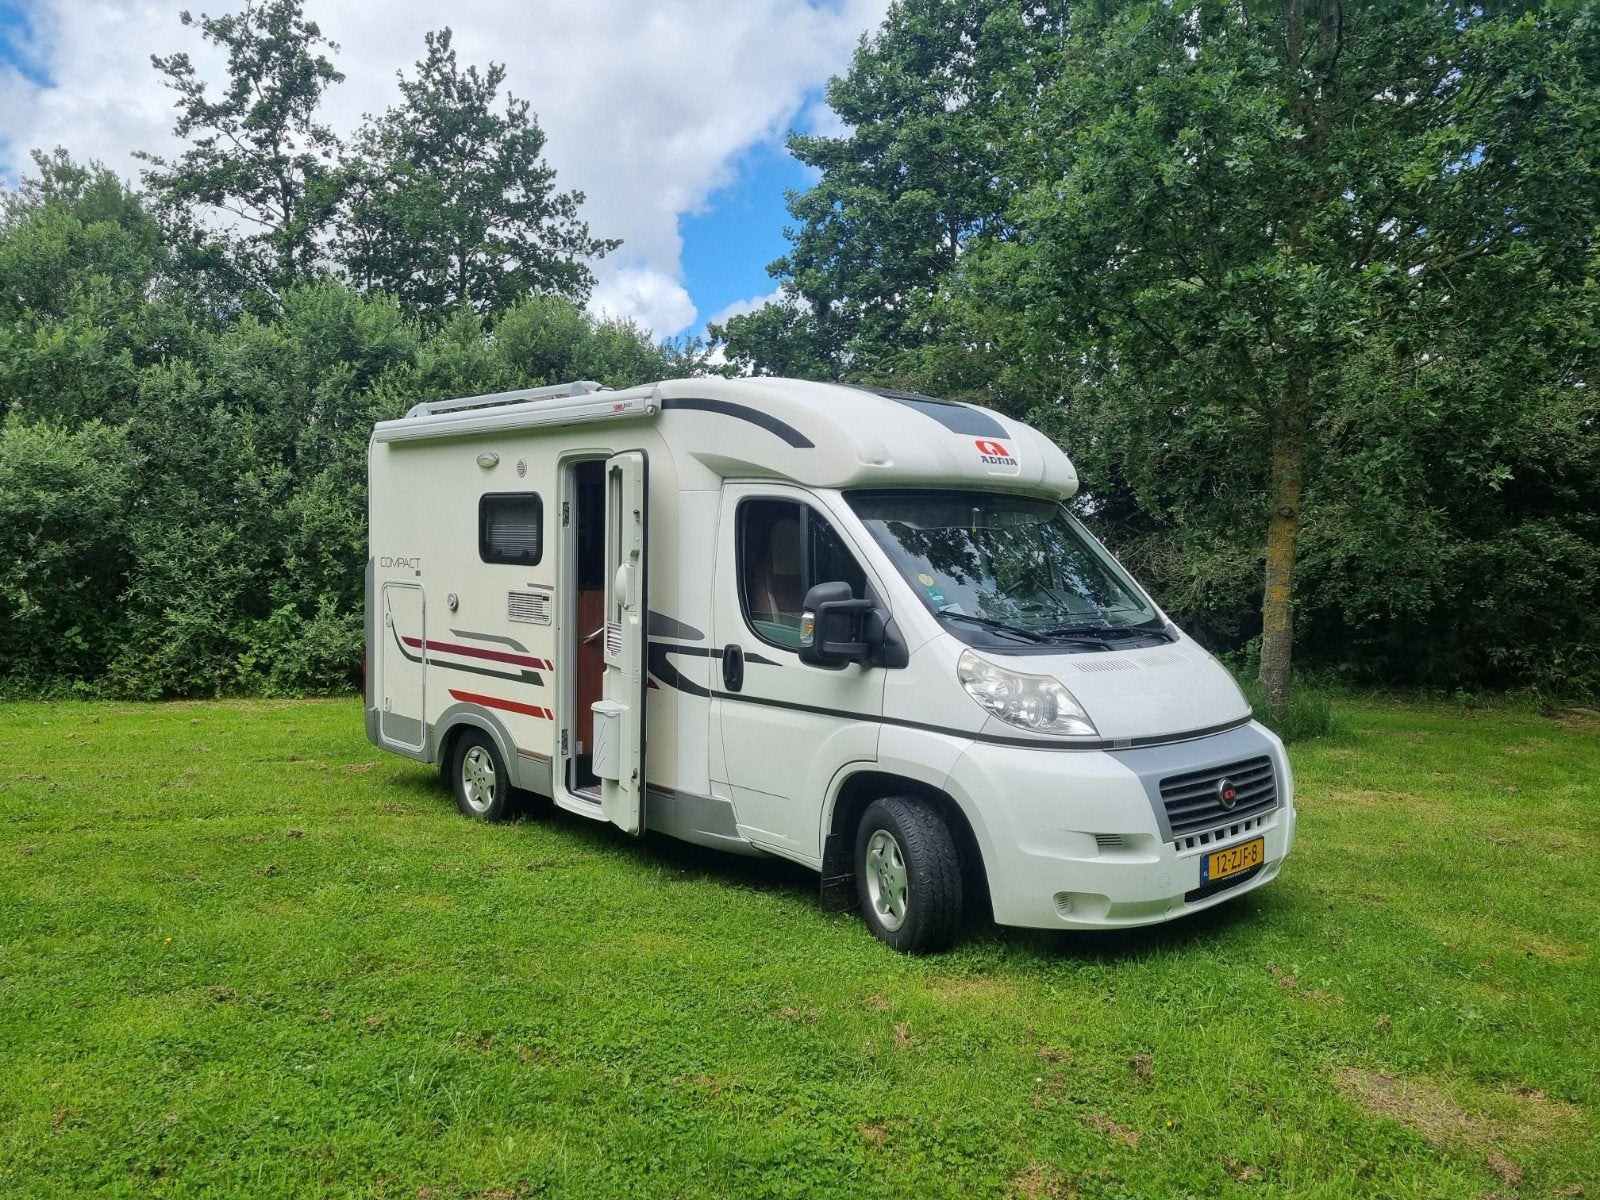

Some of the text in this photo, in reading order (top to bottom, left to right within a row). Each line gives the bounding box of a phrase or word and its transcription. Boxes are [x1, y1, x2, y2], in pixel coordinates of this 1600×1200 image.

[980, 455, 1018, 466] ADRIA
[380, 556, 421, 569] COMPACT
[1216, 844, 1258, 875] 12-ZJF-8
